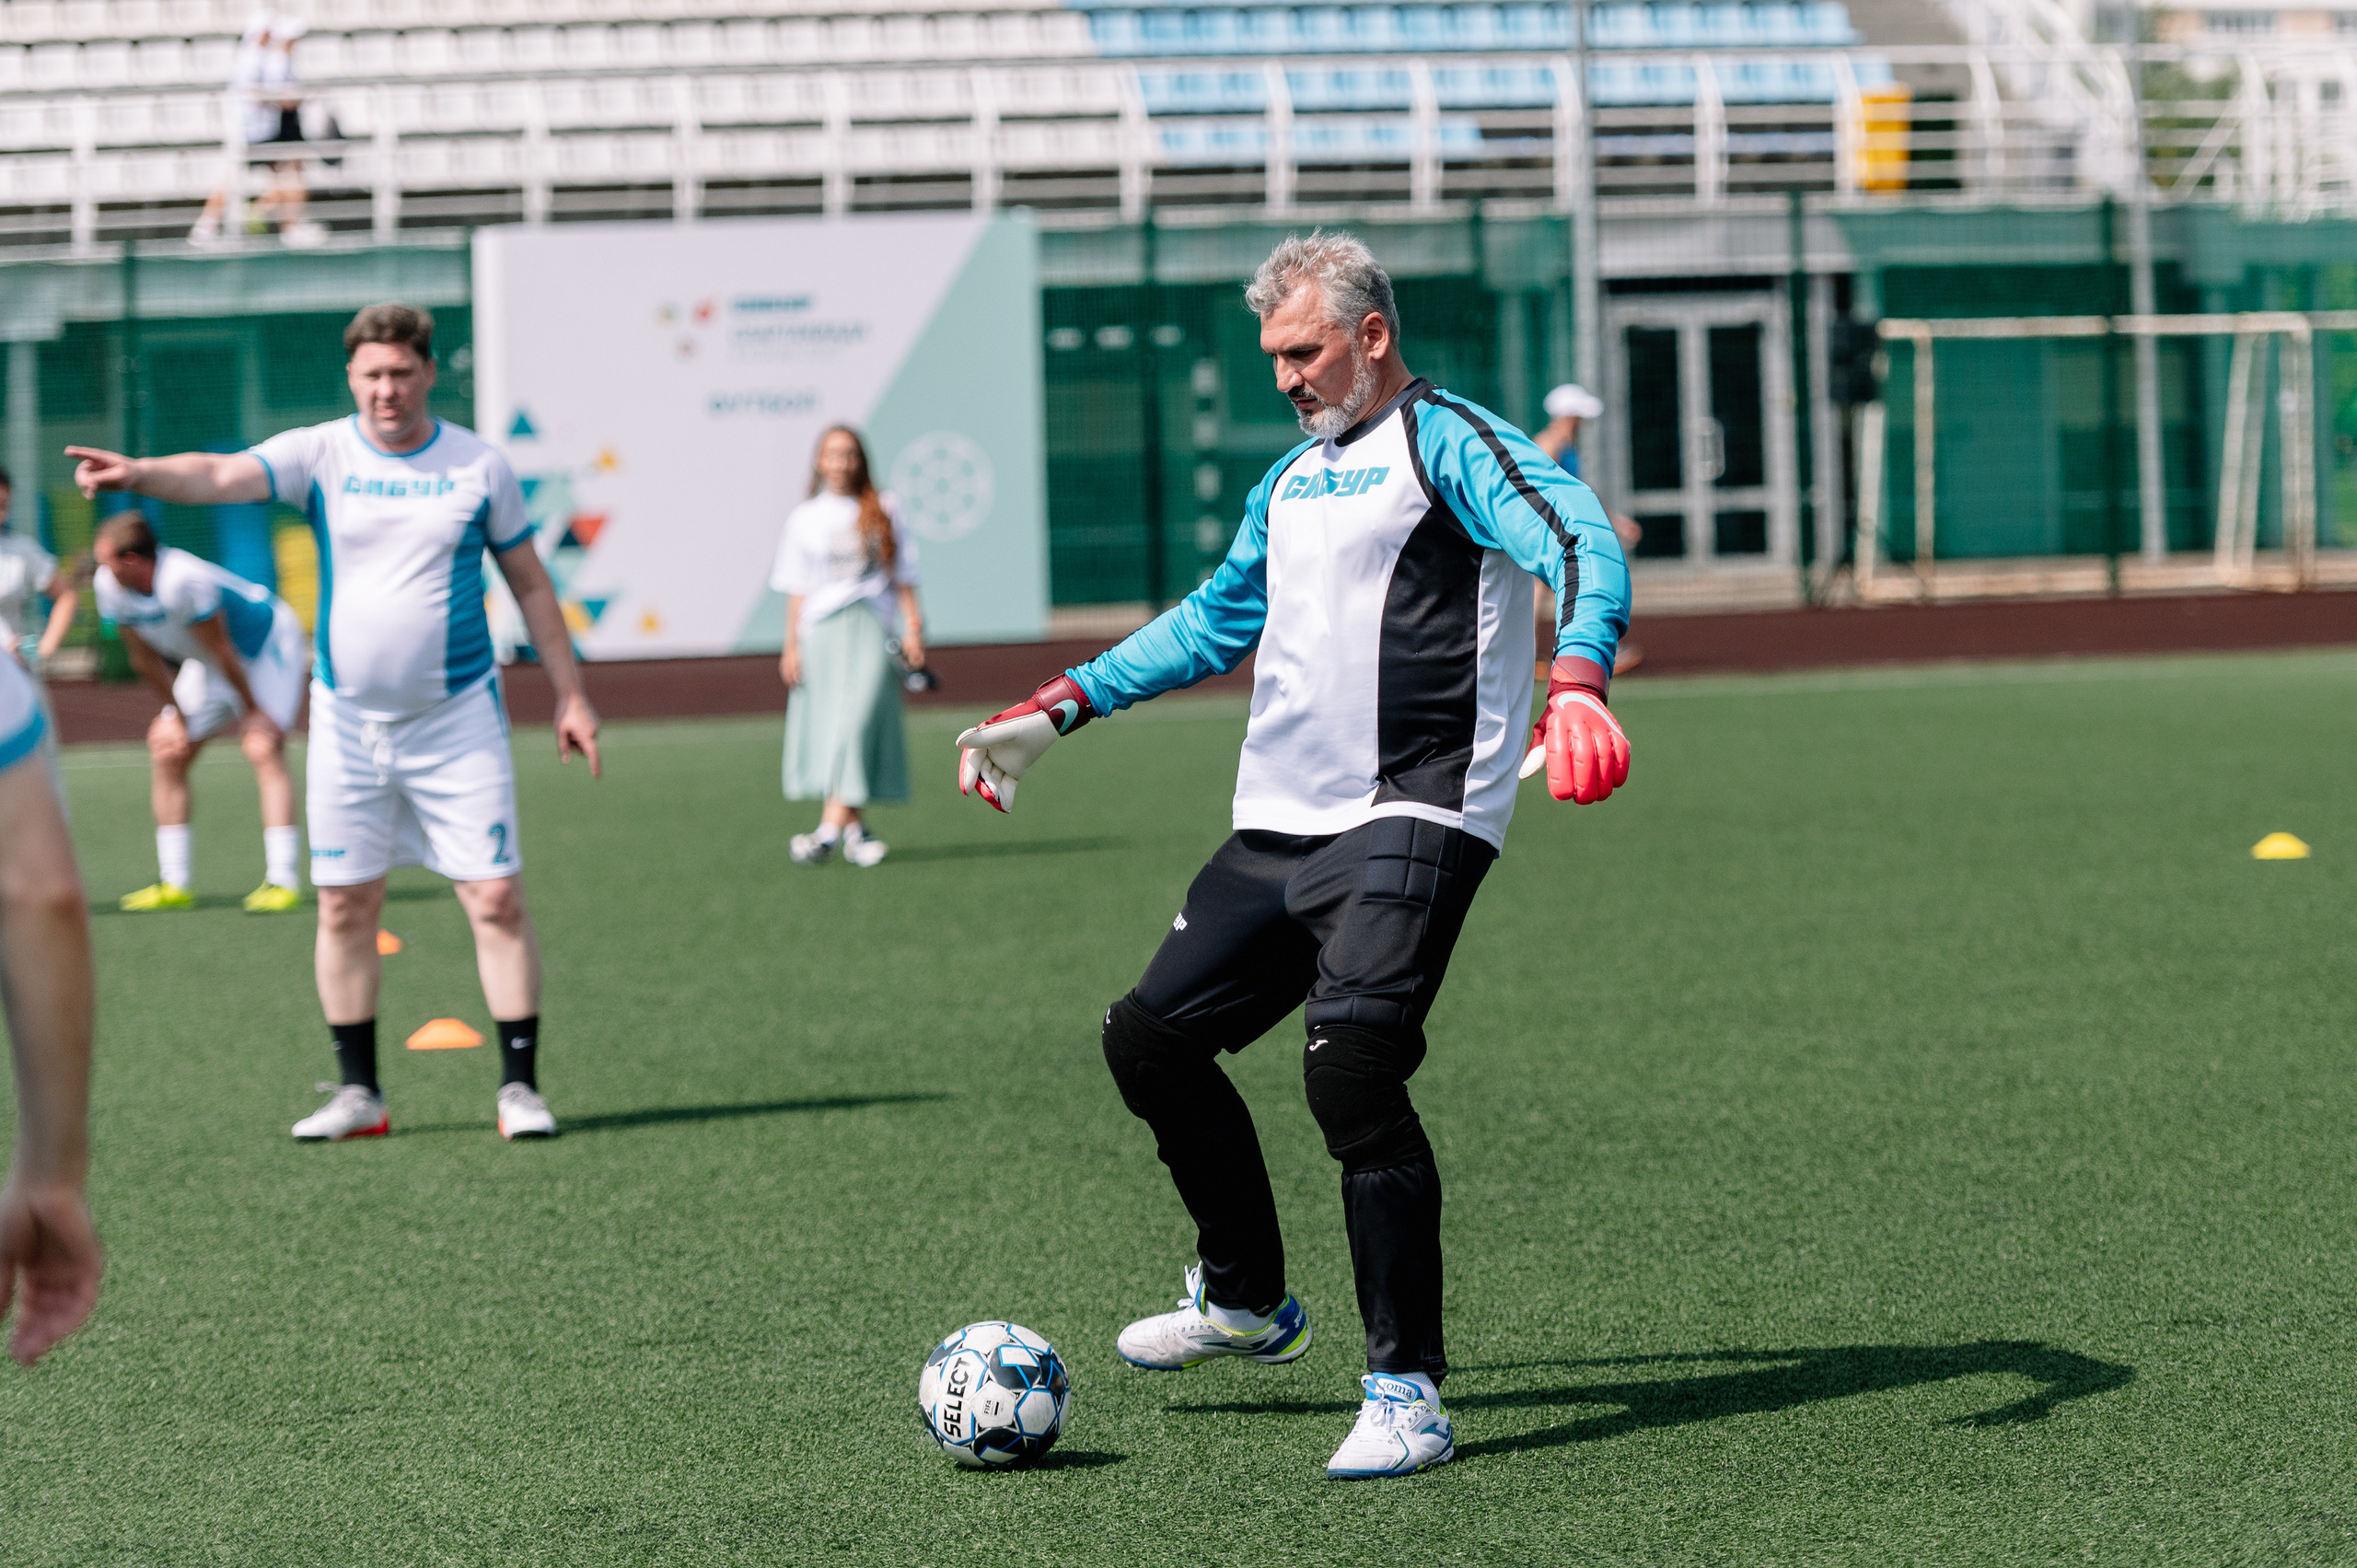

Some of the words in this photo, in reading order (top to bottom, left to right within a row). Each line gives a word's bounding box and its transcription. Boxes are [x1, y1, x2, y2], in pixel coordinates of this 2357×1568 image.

[1281, 467, 1390, 501] СИБУР
[488, 822, 509, 865] 2
[944, 1357, 971, 1438] SELECT
